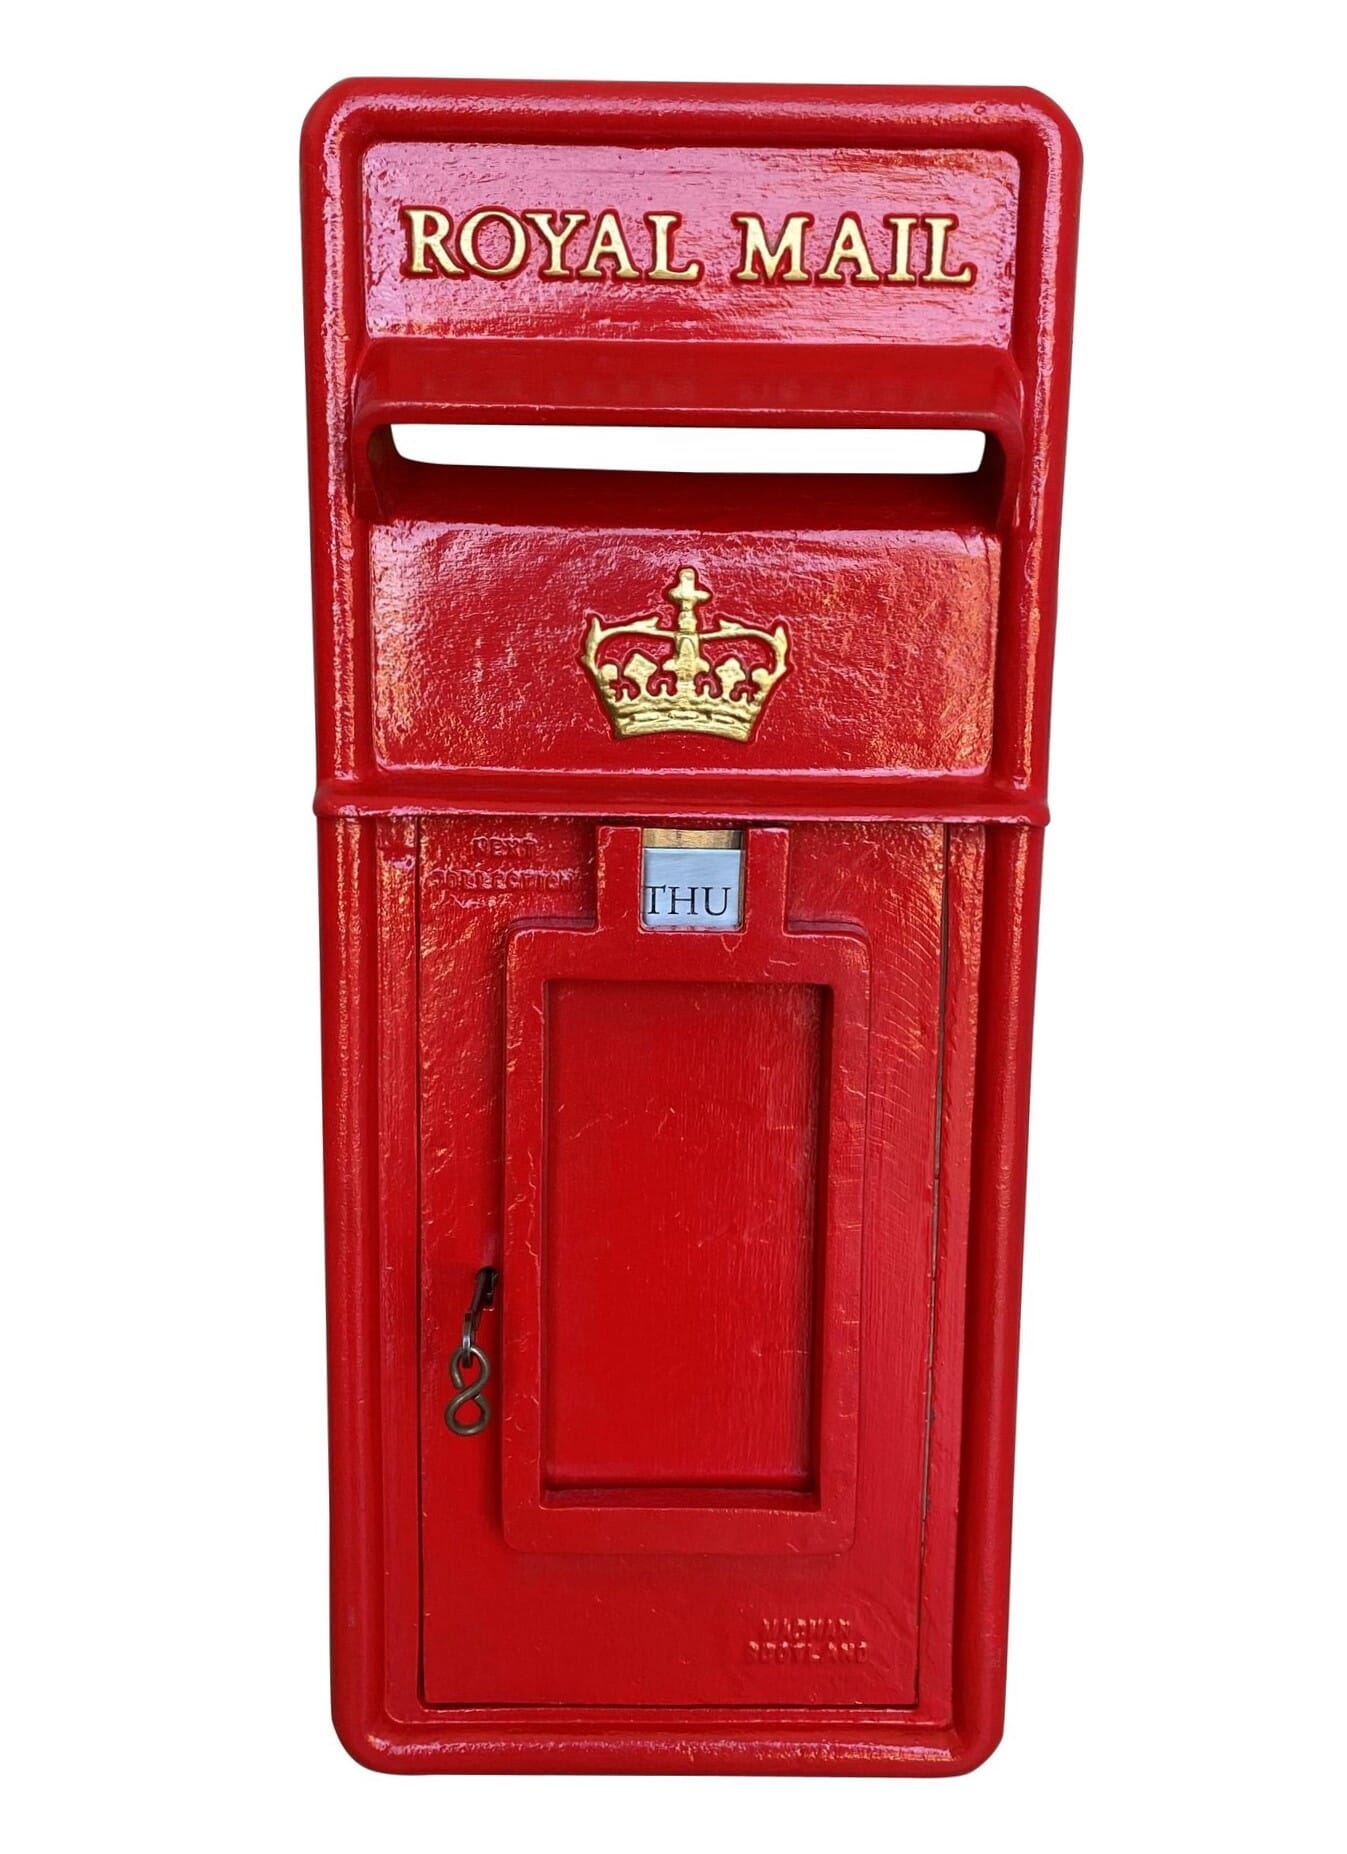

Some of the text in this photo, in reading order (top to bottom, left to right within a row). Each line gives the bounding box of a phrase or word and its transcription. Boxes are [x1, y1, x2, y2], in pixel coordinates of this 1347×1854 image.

[402, 207, 977, 286] ROYAL MAIL
[470, 836, 538, 857] NEXT
[644, 885, 731, 916] THU
[745, 1641, 869, 1664] SCOTLAND
